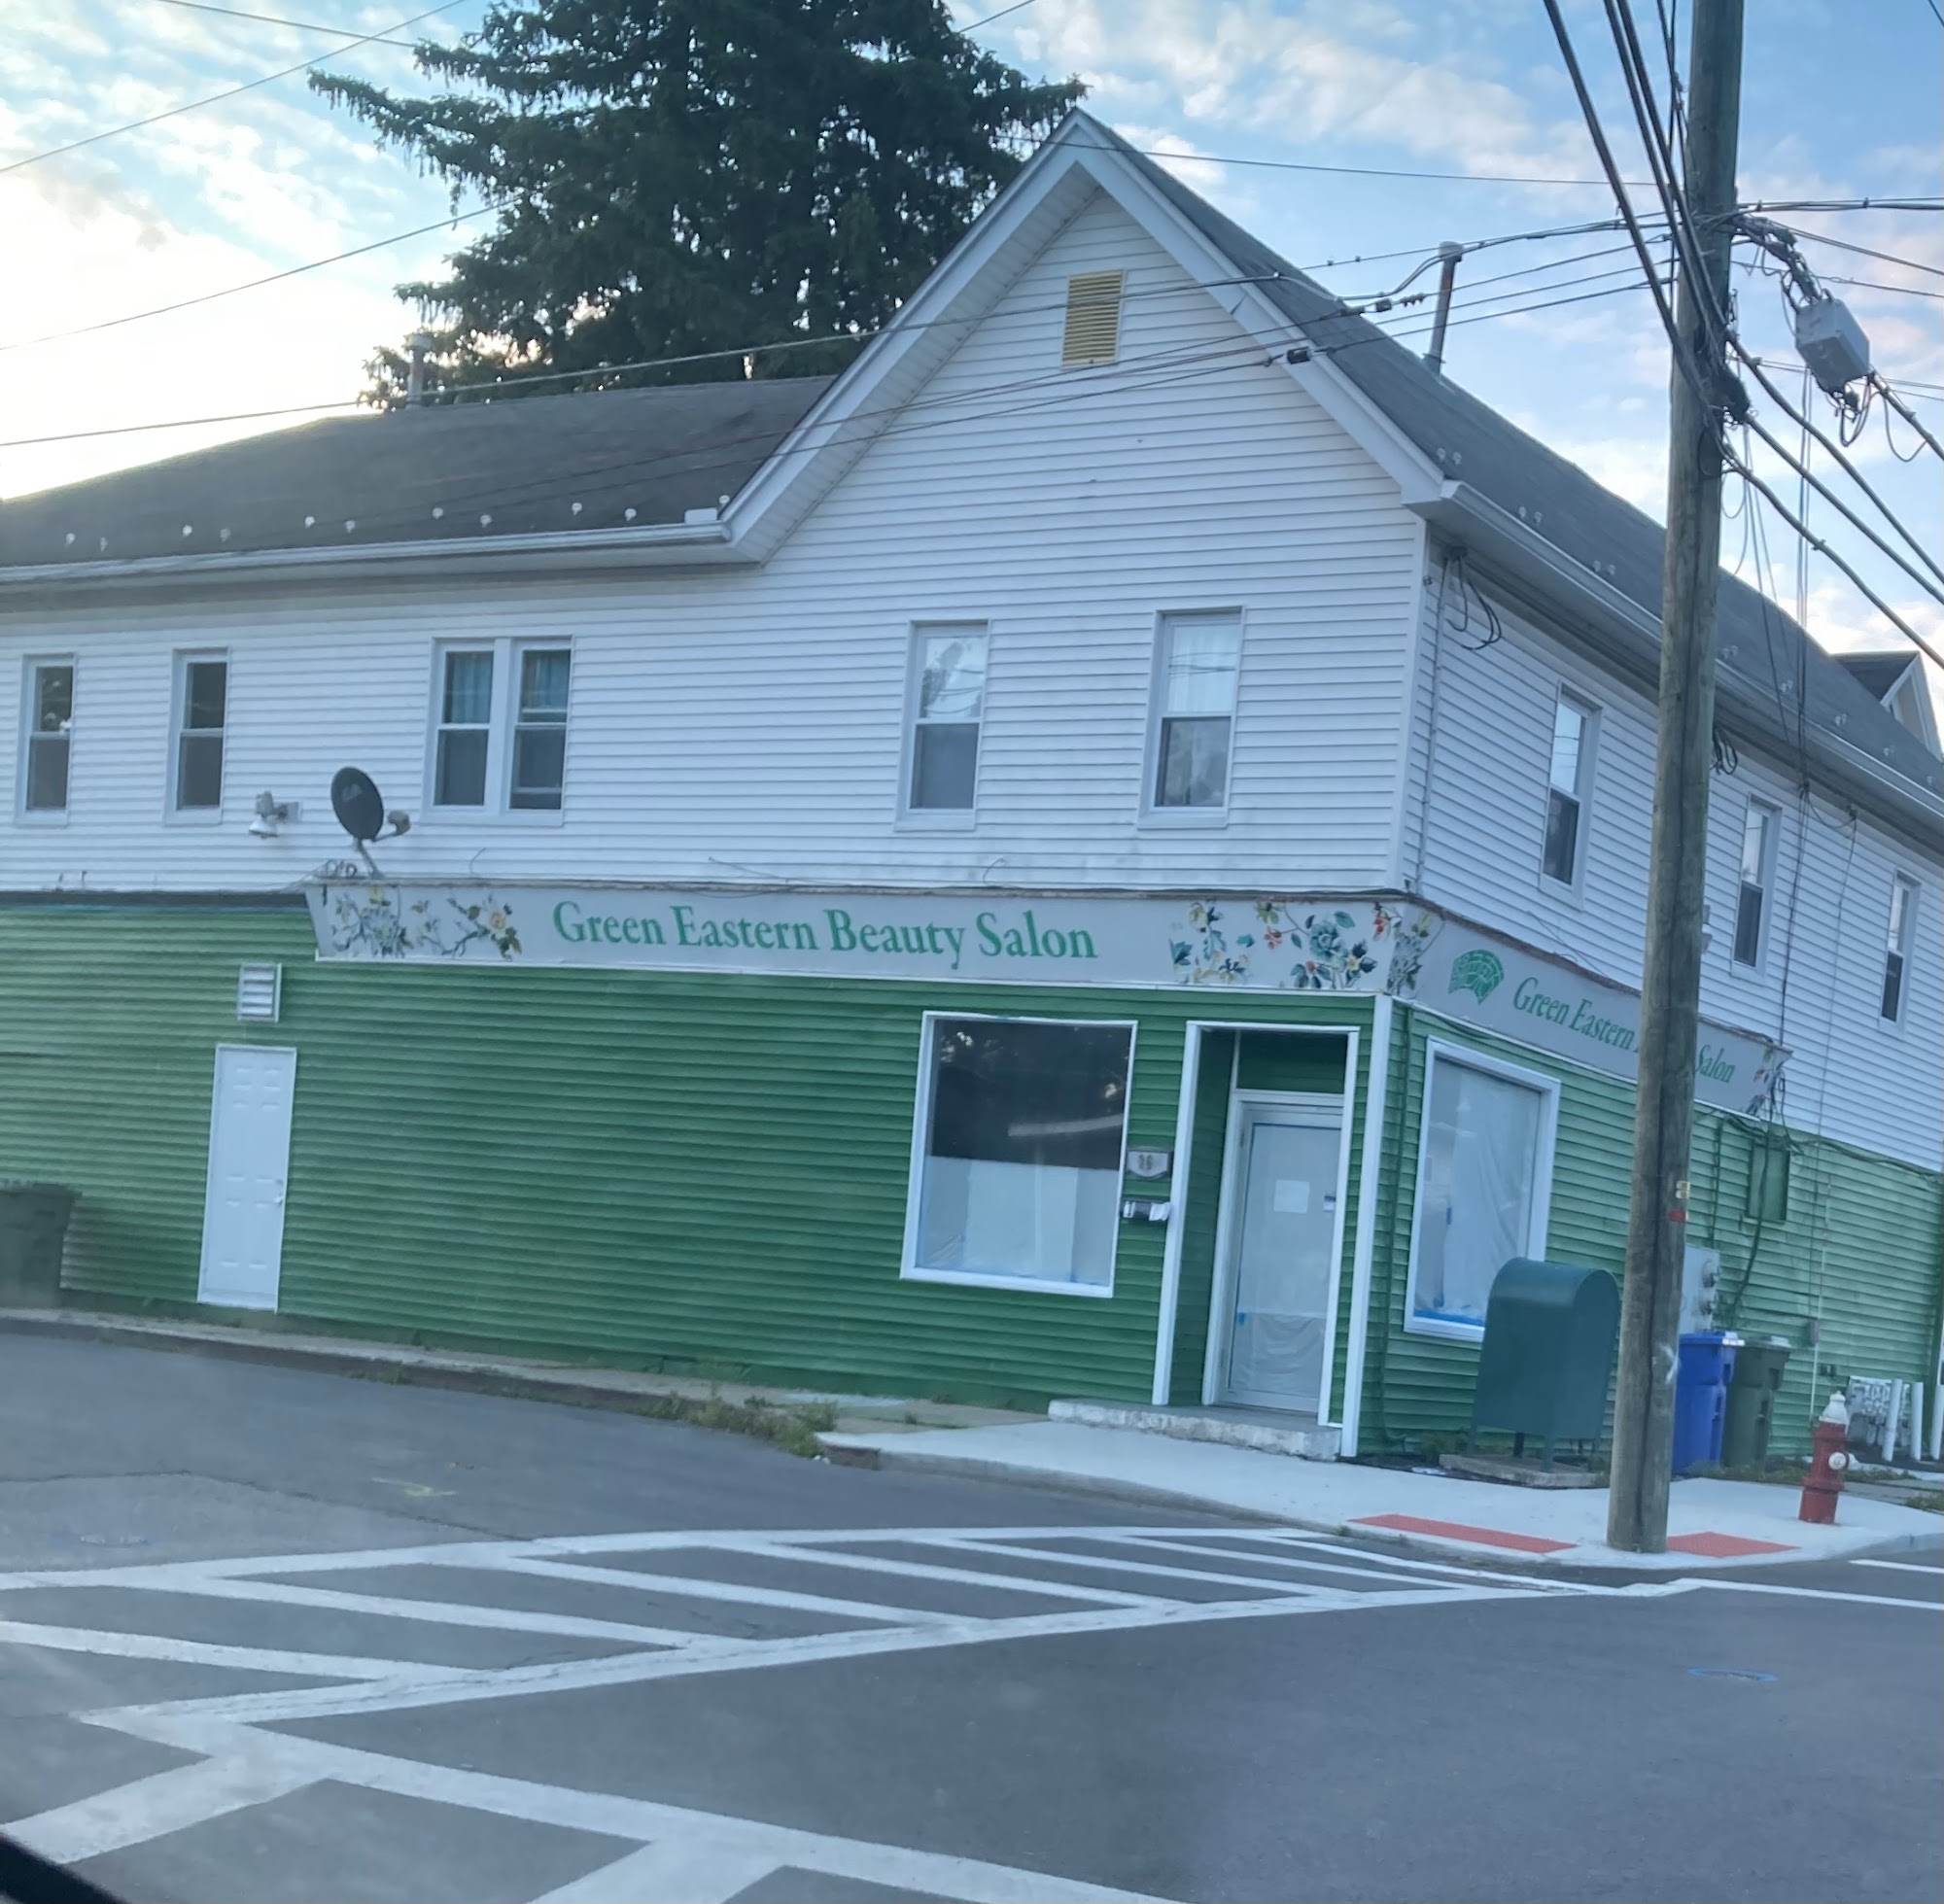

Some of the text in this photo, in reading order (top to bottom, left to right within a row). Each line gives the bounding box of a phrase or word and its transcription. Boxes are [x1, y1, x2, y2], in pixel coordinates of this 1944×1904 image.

[553, 901, 1097, 970] Green Eastern Beauty Salon
[1513, 977, 1735, 1083] Green Eastern Salon
